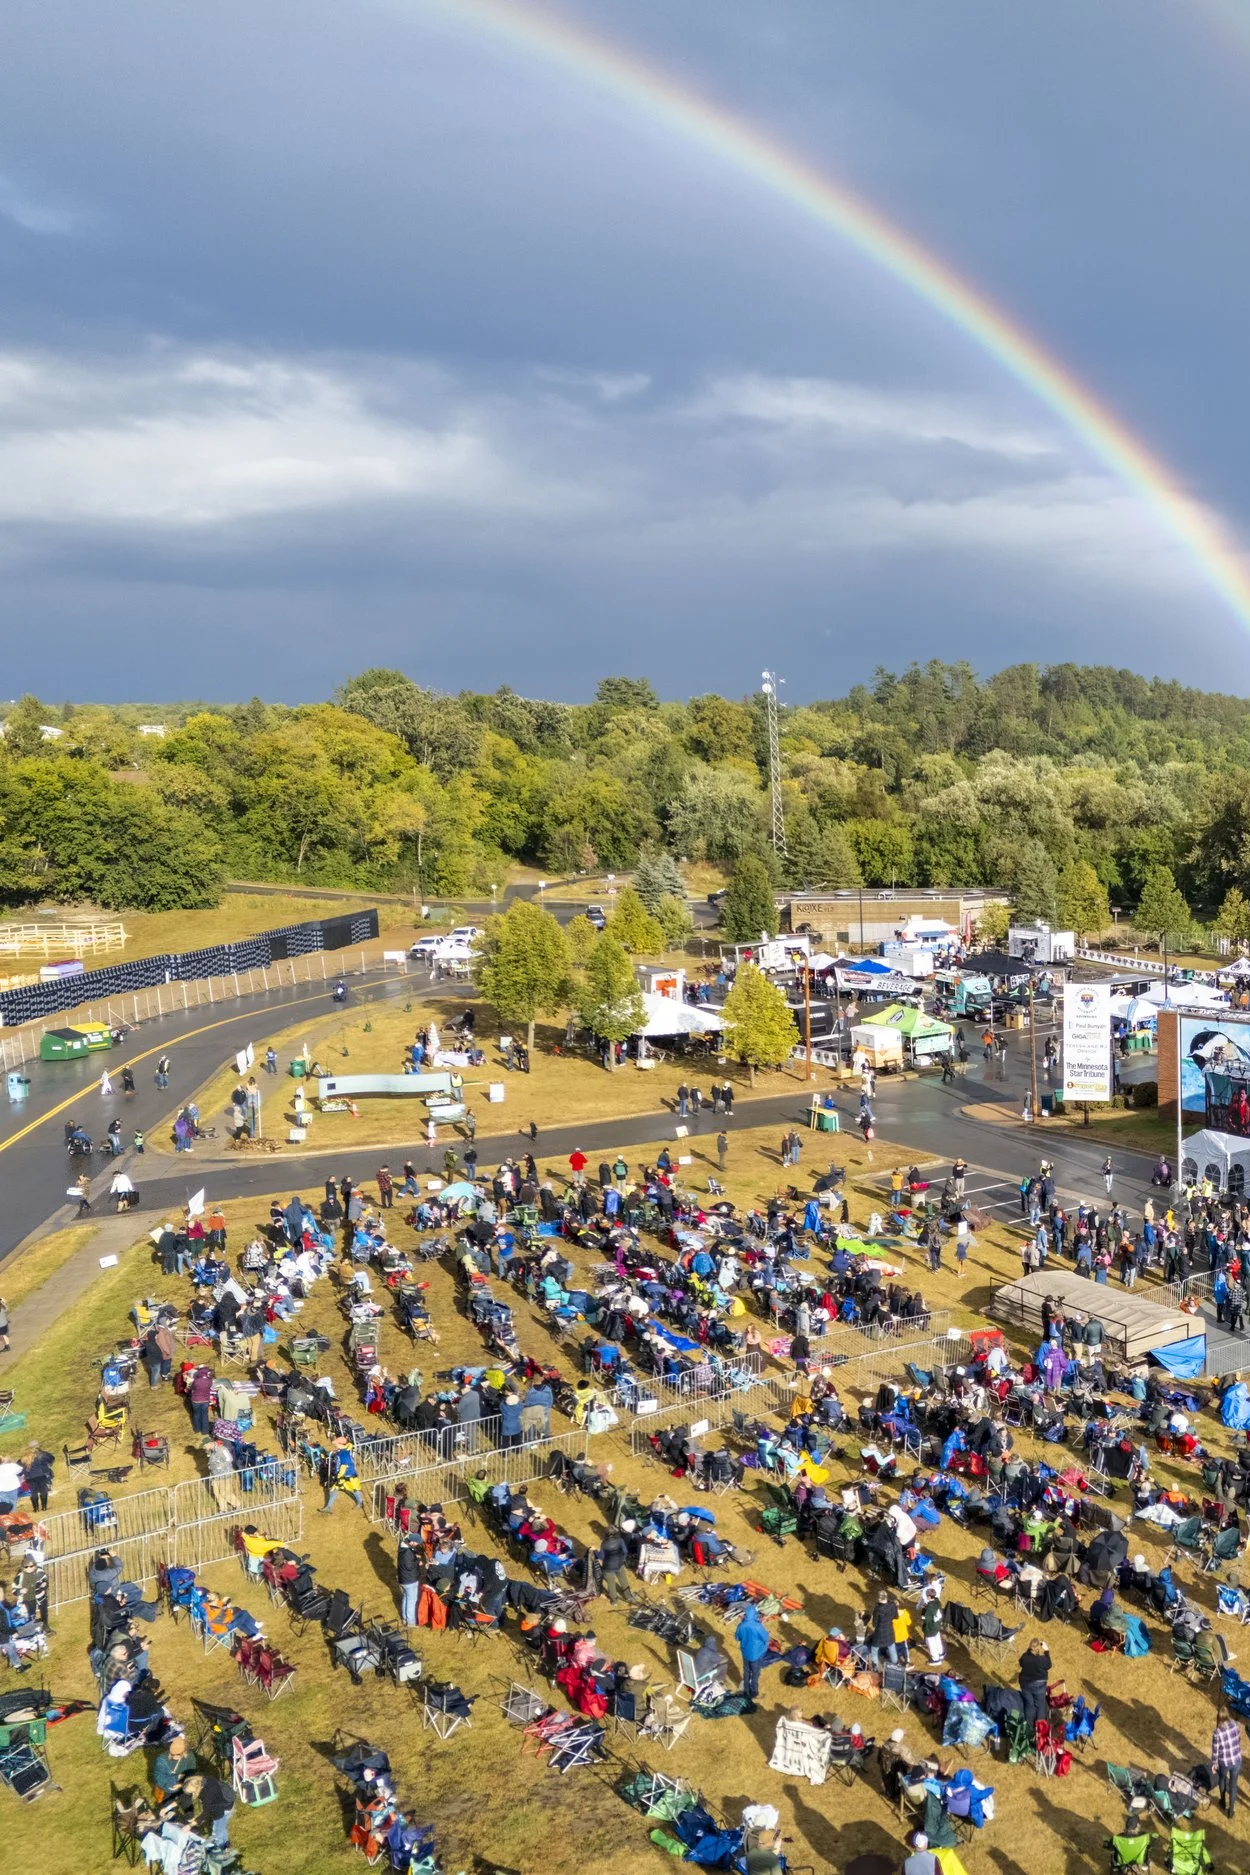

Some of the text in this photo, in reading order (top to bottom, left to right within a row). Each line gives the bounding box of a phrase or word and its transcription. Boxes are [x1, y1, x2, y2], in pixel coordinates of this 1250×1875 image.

[876, 981, 913, 993] BEVERAGE
[1066, 1062, 1109, 1071] The Minnesota
